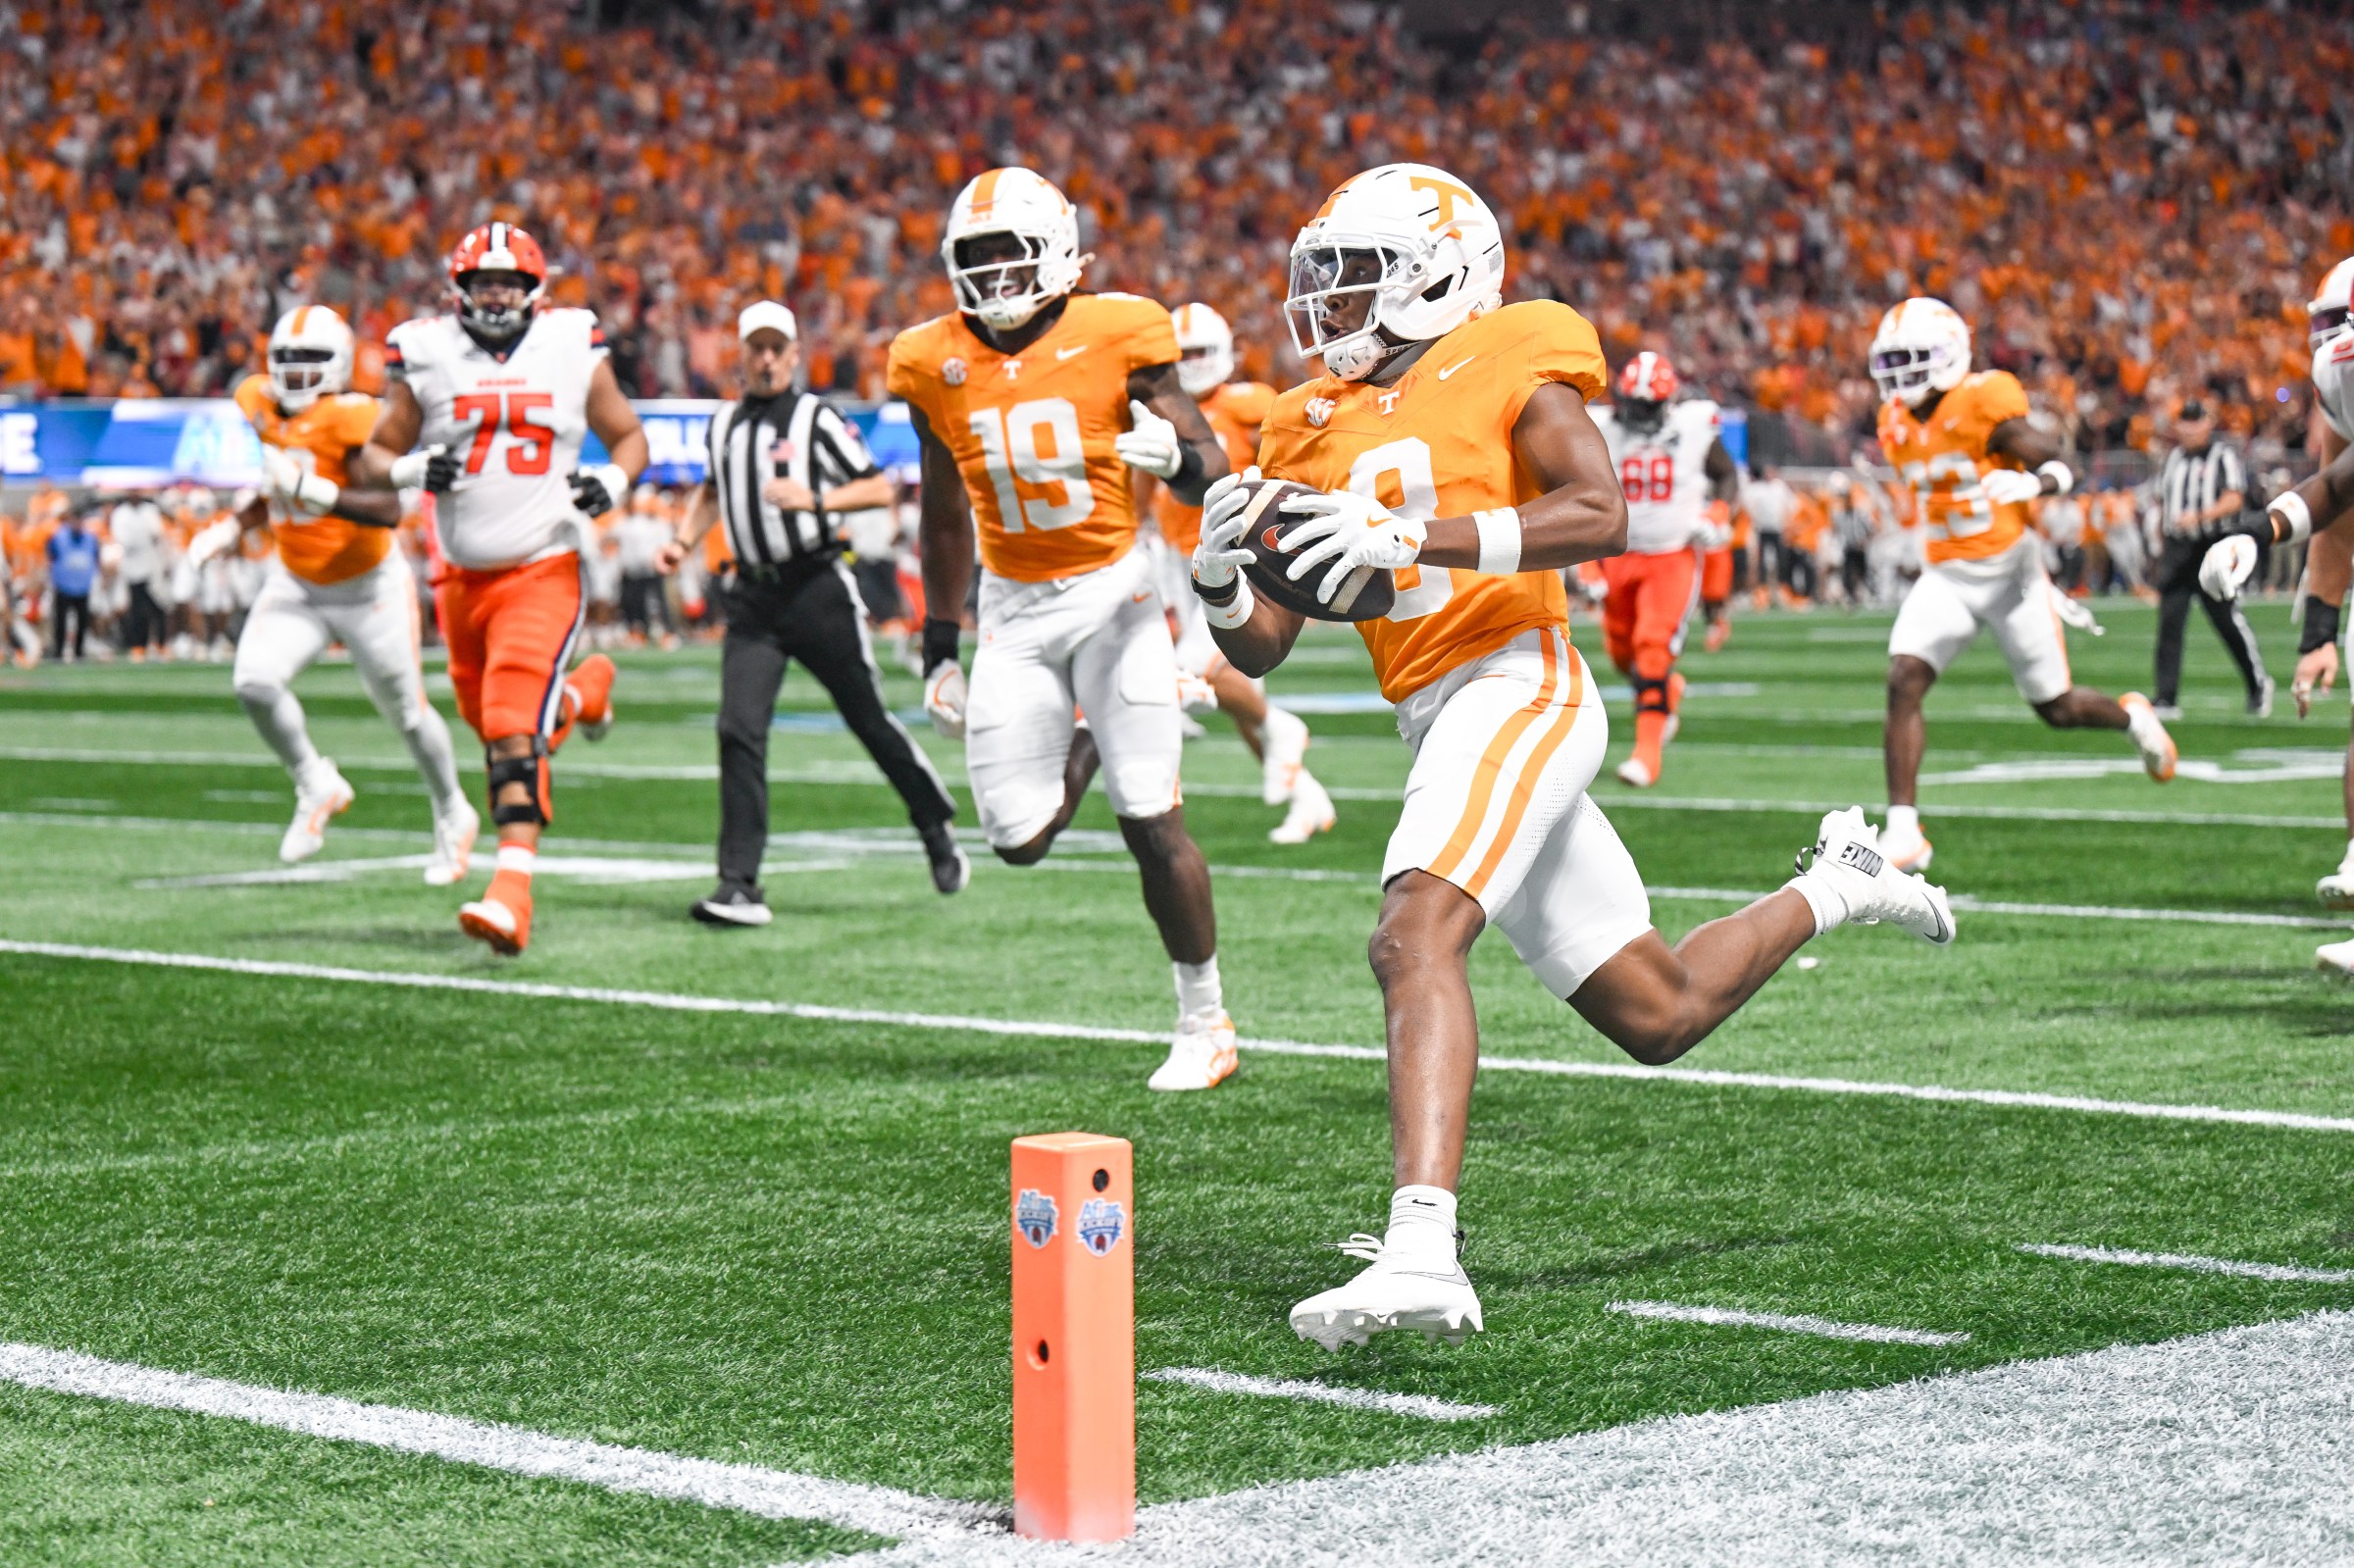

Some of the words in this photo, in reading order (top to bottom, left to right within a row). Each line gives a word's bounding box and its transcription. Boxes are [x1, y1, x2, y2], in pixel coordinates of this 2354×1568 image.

[1408, 176, 1474, 241] T
[1002, 360, 1022, 380] T
[453, 393, 555, 476] 75
[1378, 391, 1400, 416] T
[969, 396, 1096, 532] 19
[1349, 436, 1454, 623] 8
[1838, 840, 1884, 878] NIKE
